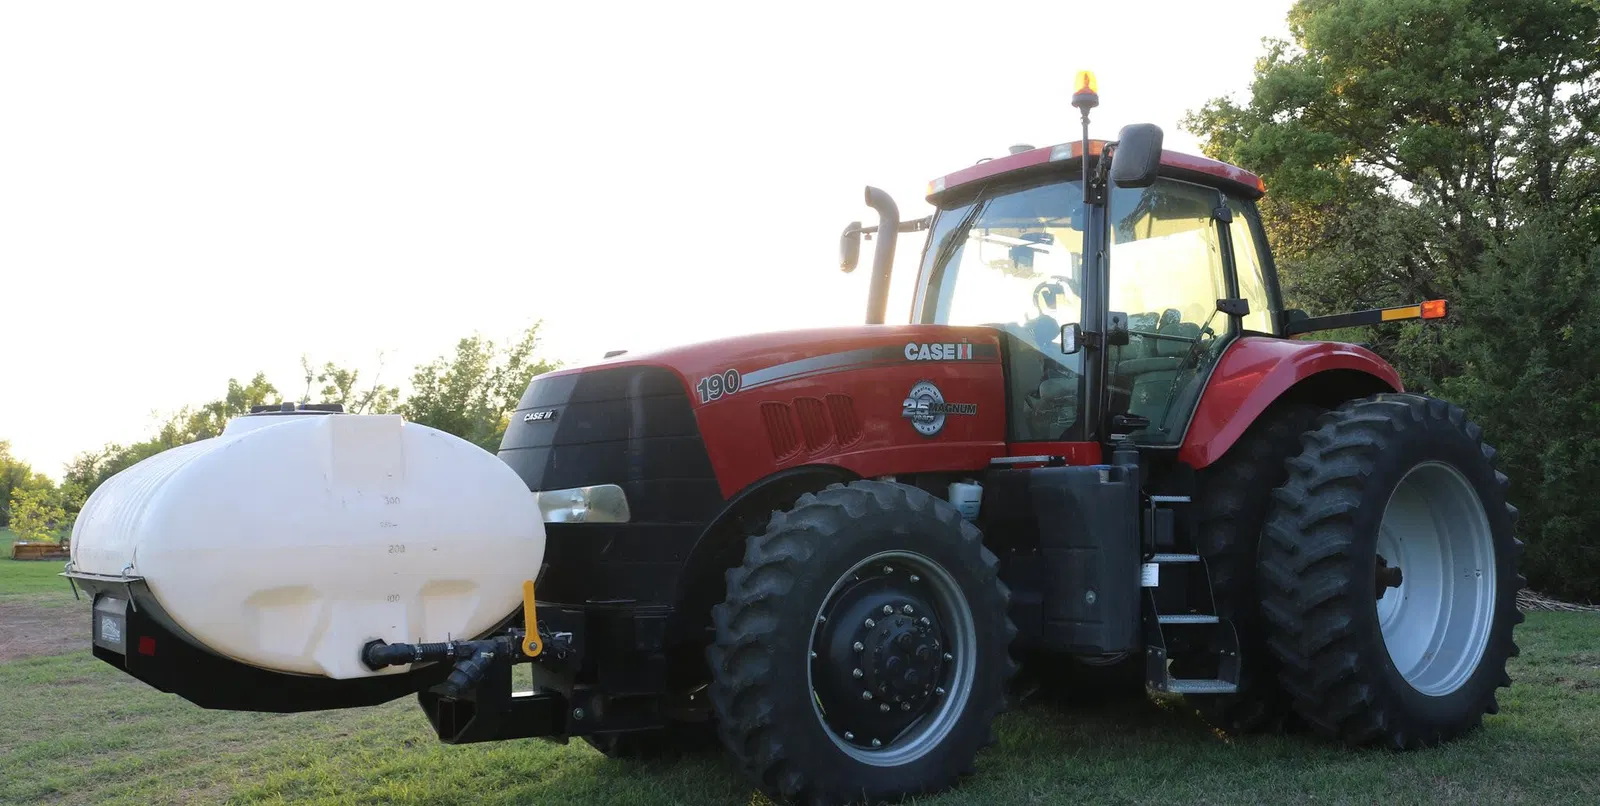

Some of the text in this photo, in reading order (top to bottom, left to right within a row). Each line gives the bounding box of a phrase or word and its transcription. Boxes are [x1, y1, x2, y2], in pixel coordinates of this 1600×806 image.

[904, 342, 955, 360] CASE
[696, 368, 740, 404] 190
[902, 398, 977, 416] 25 MAGNUM
[524, 411, 545, 421] CASE
[383, 496, 401, 505] 300
[388, 544, 406, 553] 200
[387, 594, 400, 602] 100
